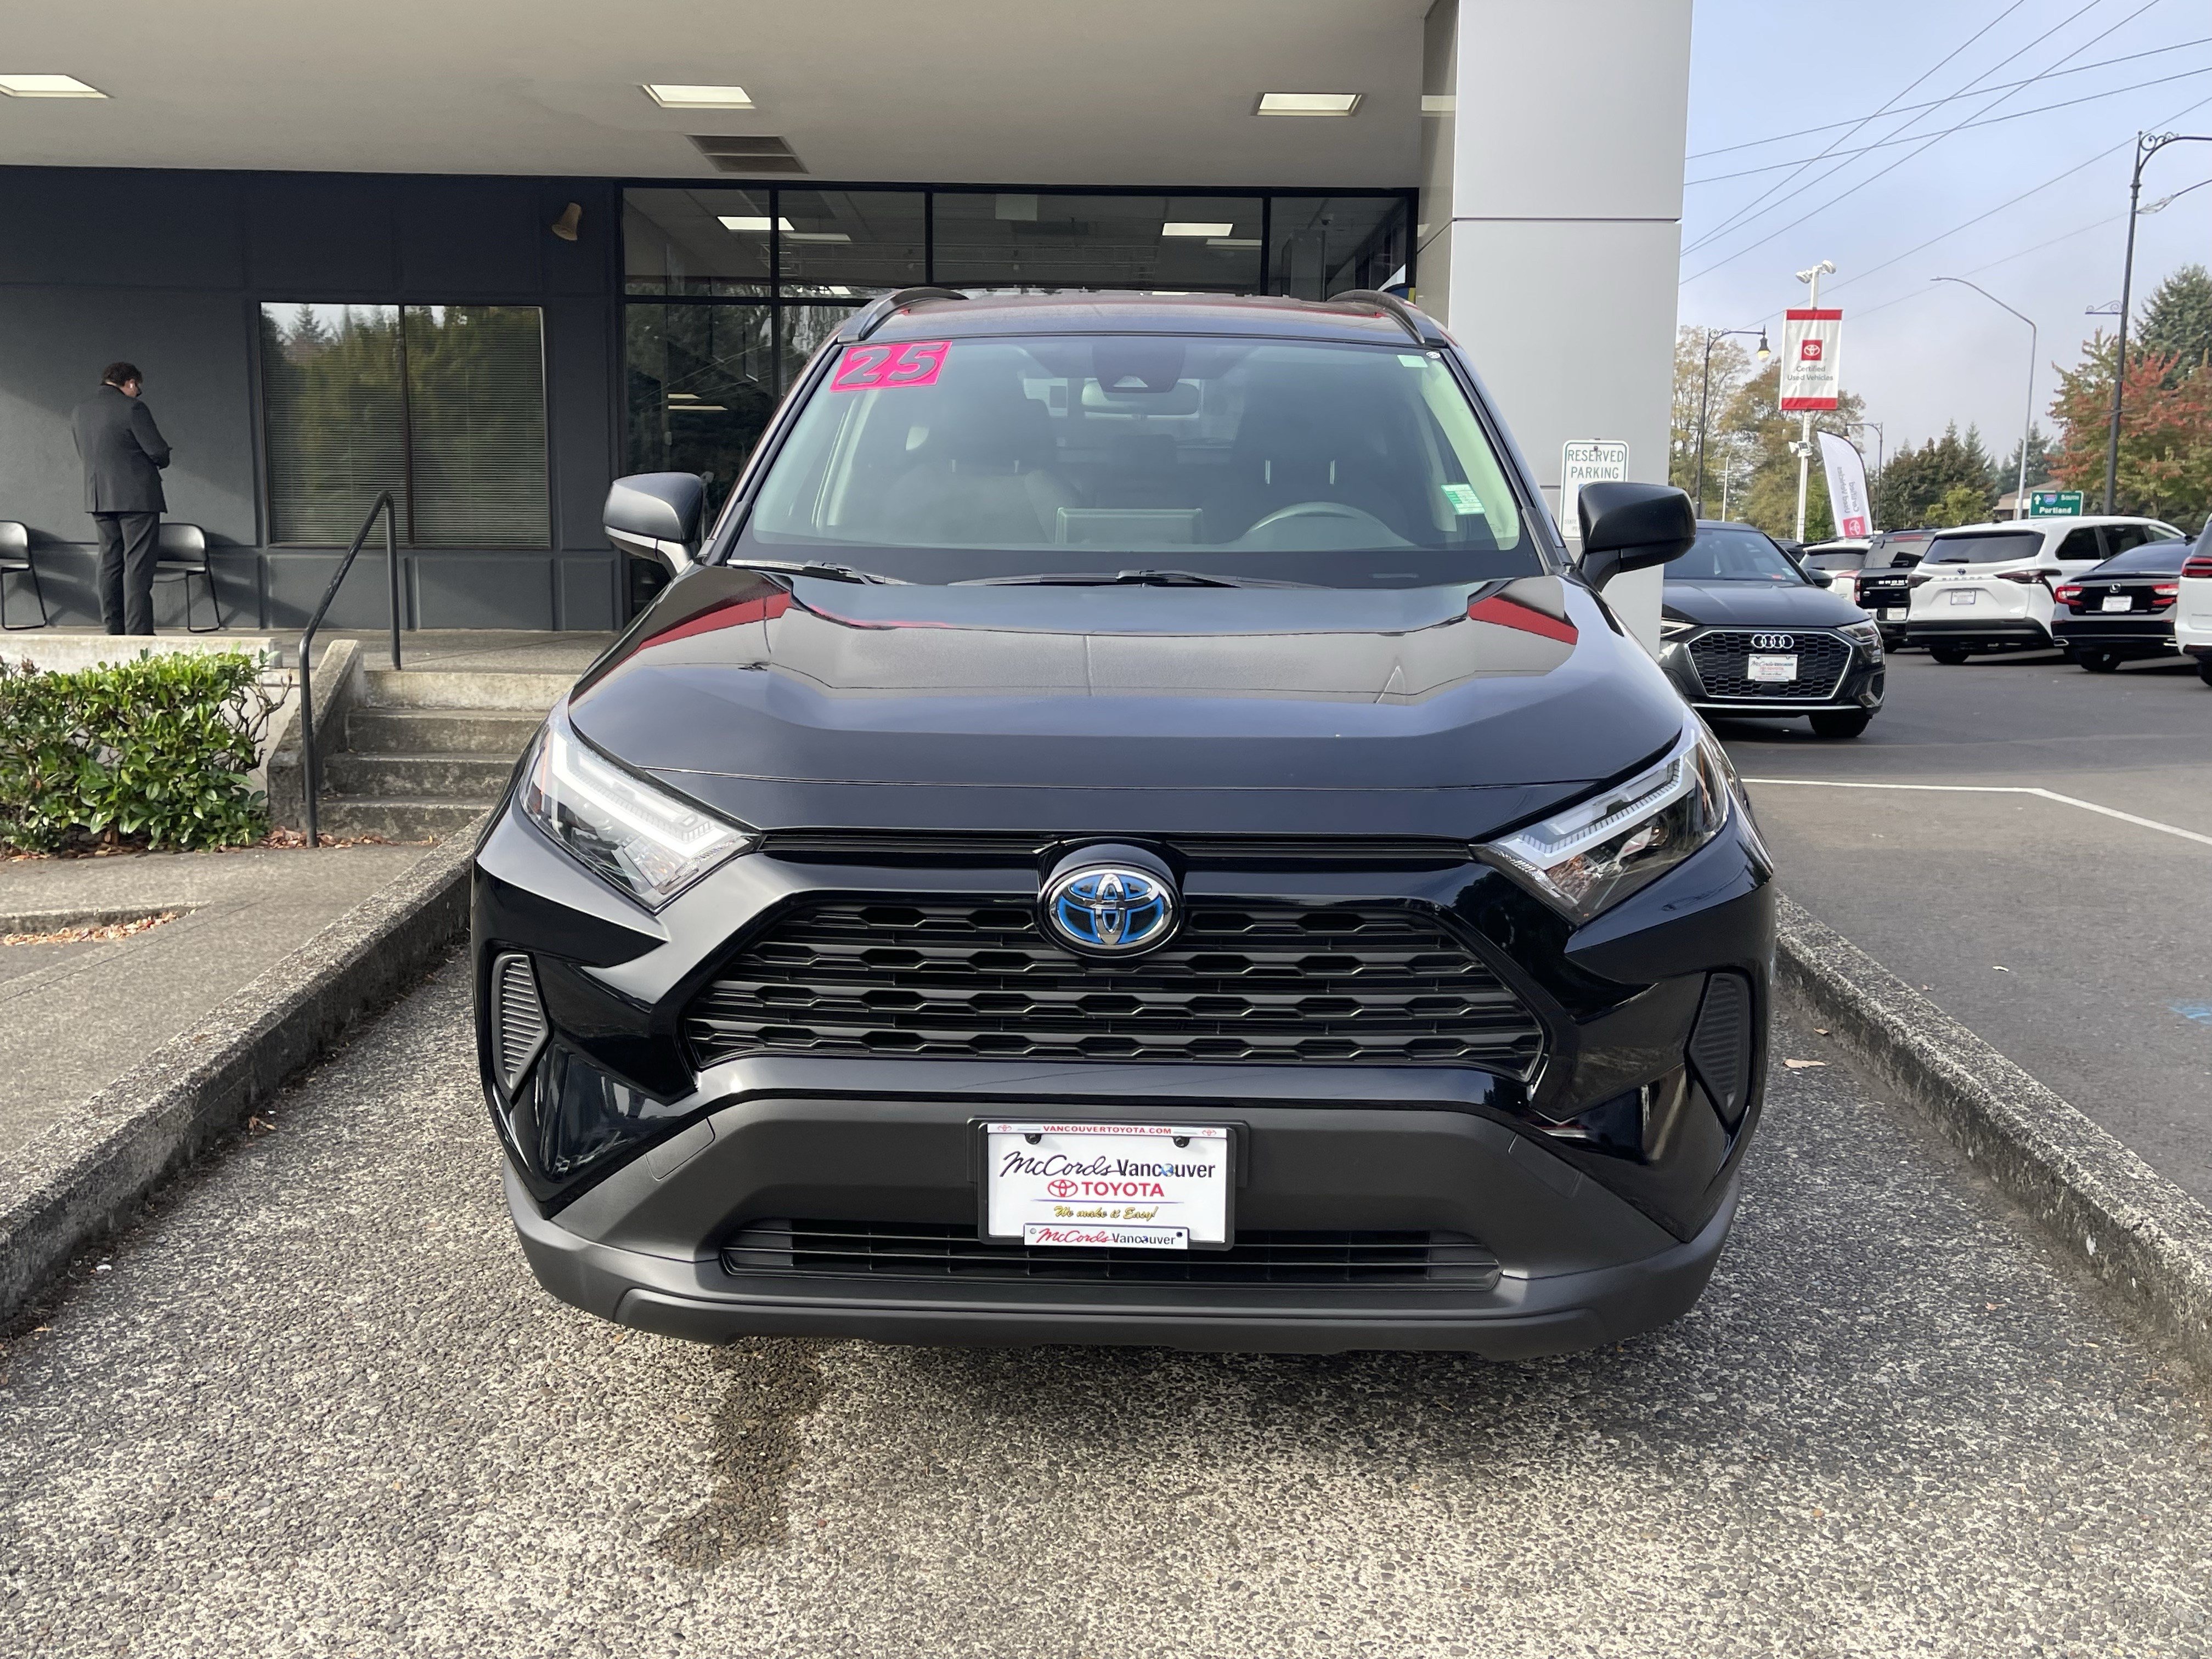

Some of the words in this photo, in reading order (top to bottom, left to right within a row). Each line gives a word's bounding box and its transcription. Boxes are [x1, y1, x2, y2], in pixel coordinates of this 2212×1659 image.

[838, 345, 945, 386] 25
[1567, 450, 1624, 462] RESERVED
[1571, 467, 1619, 479] PARKING
[1043, 1125, 1172, 1135] VANCOUVERTOYOTA.COM
[1081, 1181, 1165, 1197] TOYOTA
[1054, 1205, 1074, 1217] We
[1076, 1207, 1107, 1218] make
[1110, 1209, 1120, 1218] it
[1122, 1206, 1159, 1222] Easy!
